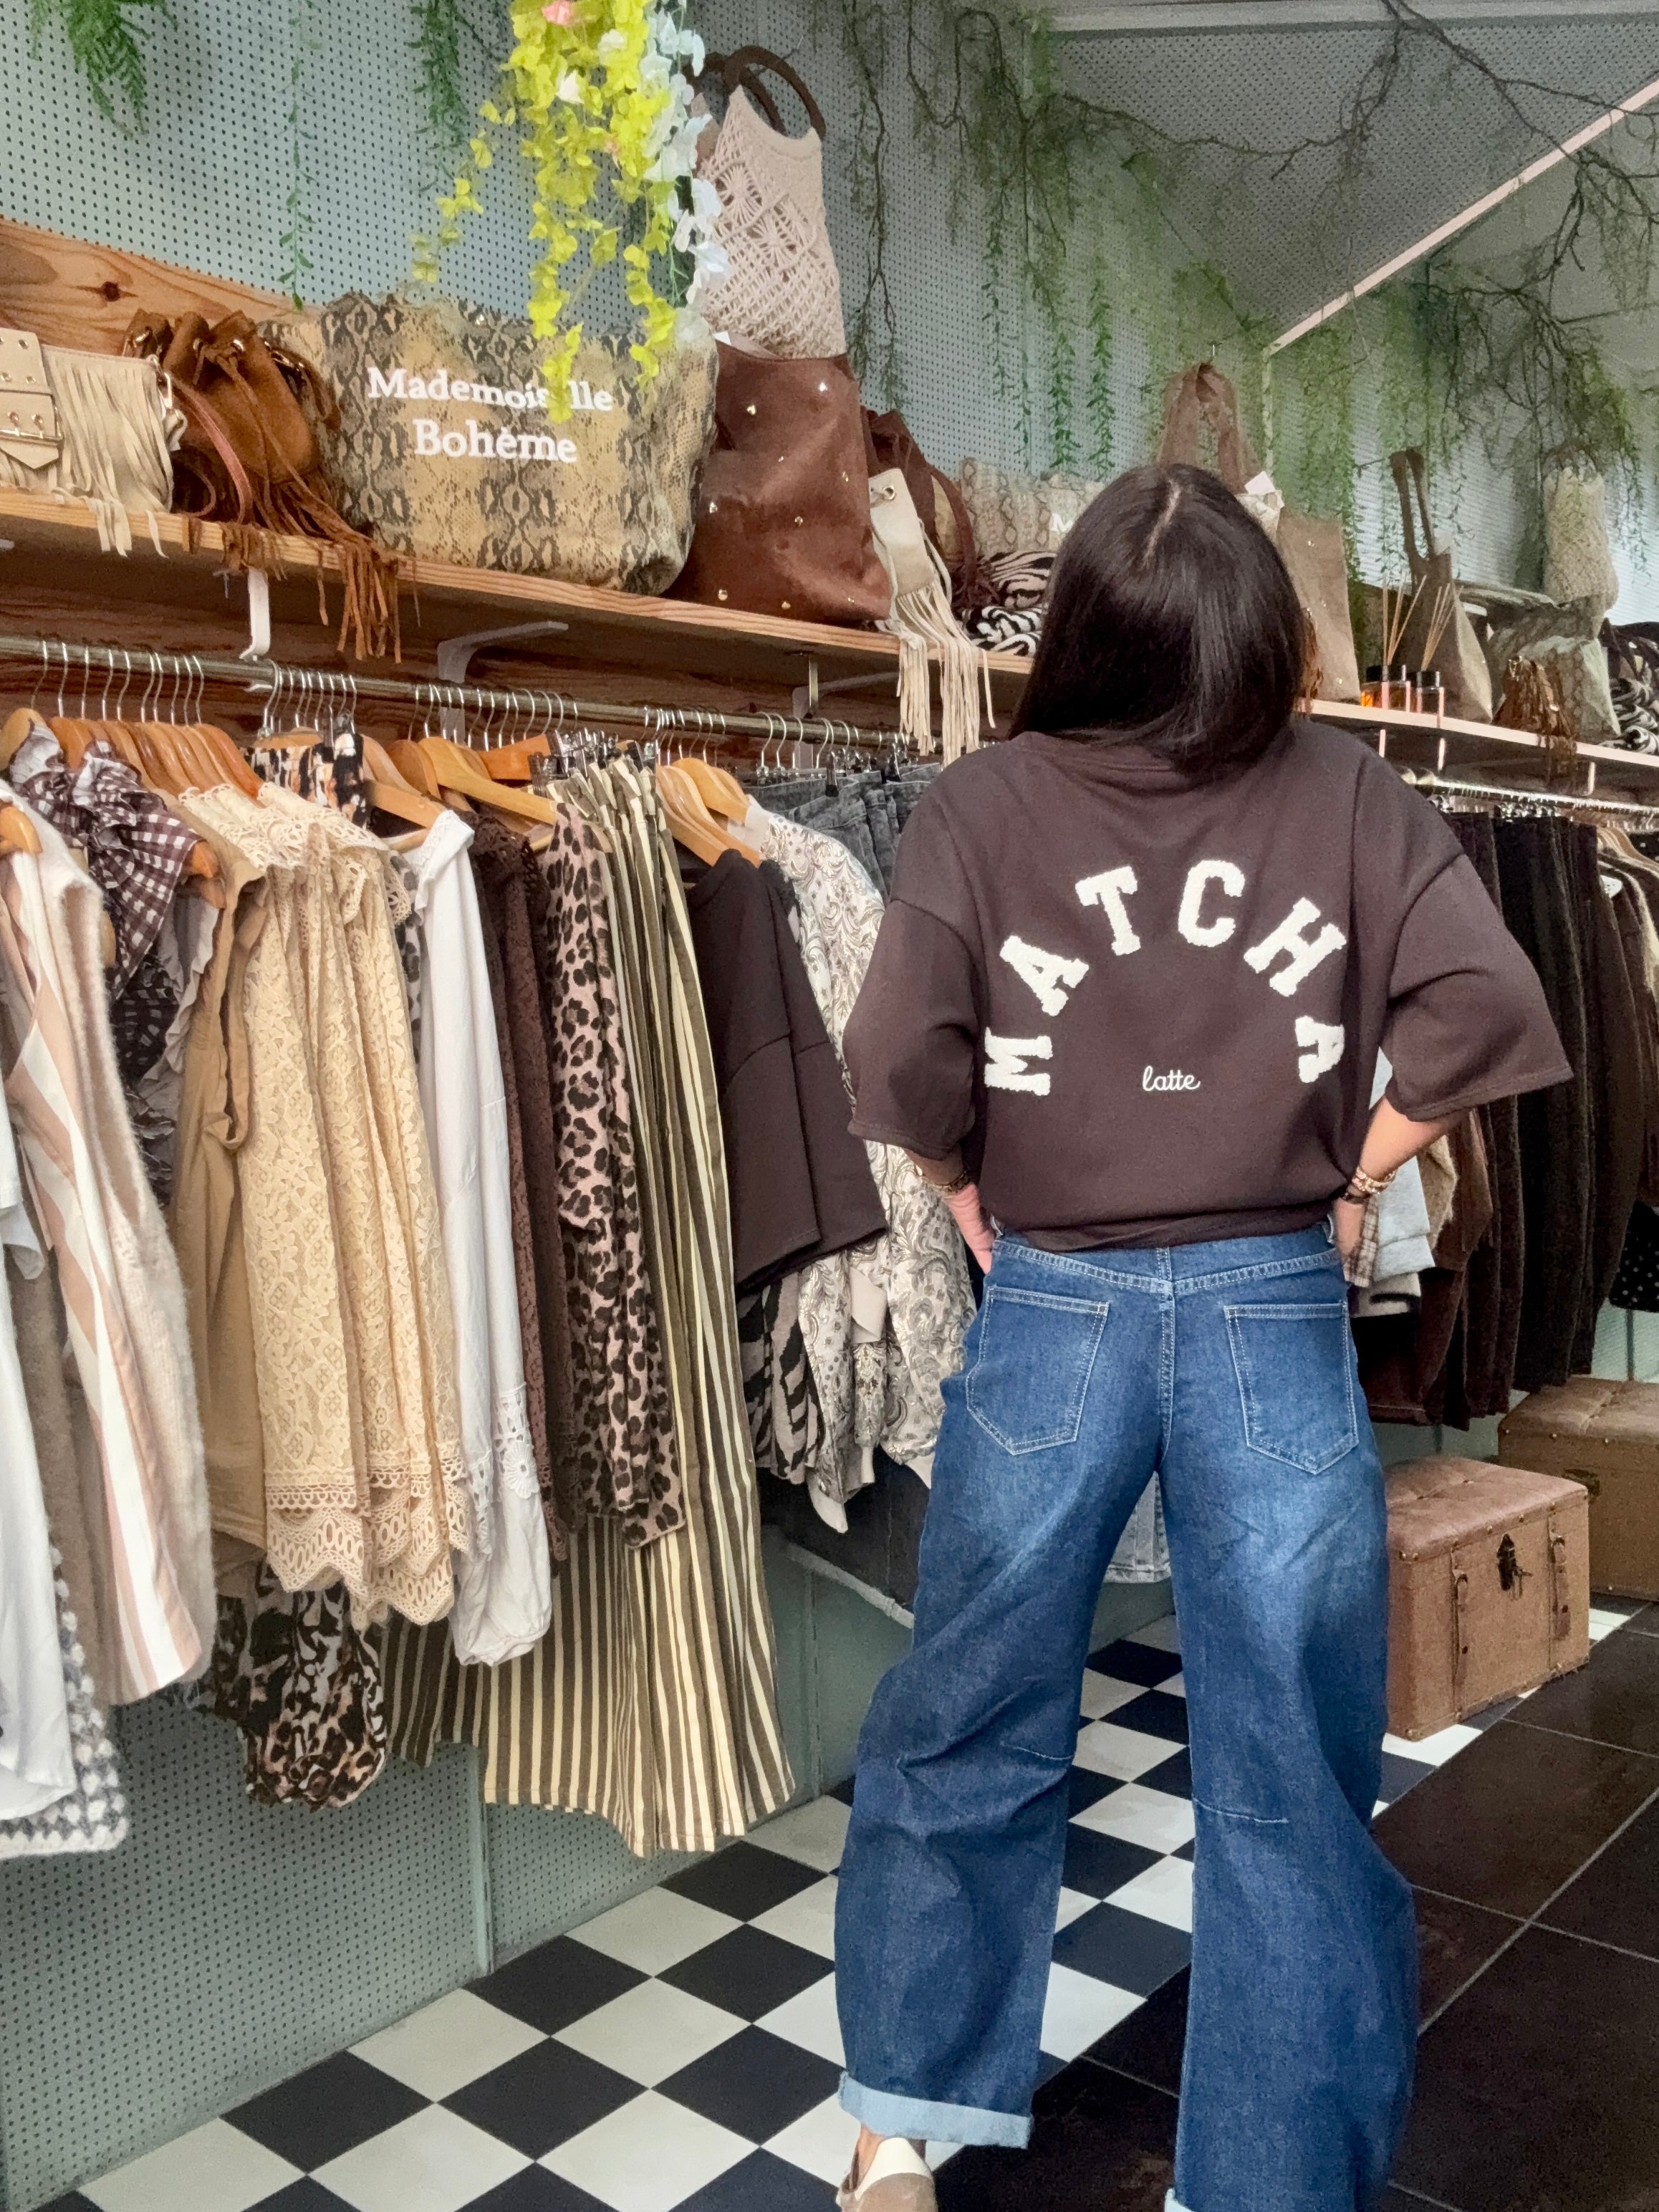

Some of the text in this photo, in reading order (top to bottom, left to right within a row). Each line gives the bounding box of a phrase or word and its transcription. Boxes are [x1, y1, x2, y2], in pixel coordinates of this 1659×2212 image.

[367, 366, 612, 412] Mademoislle
[984, 860, 1347, 1097] MATCHA
[1142, 1065, 1201, 1092] latte
